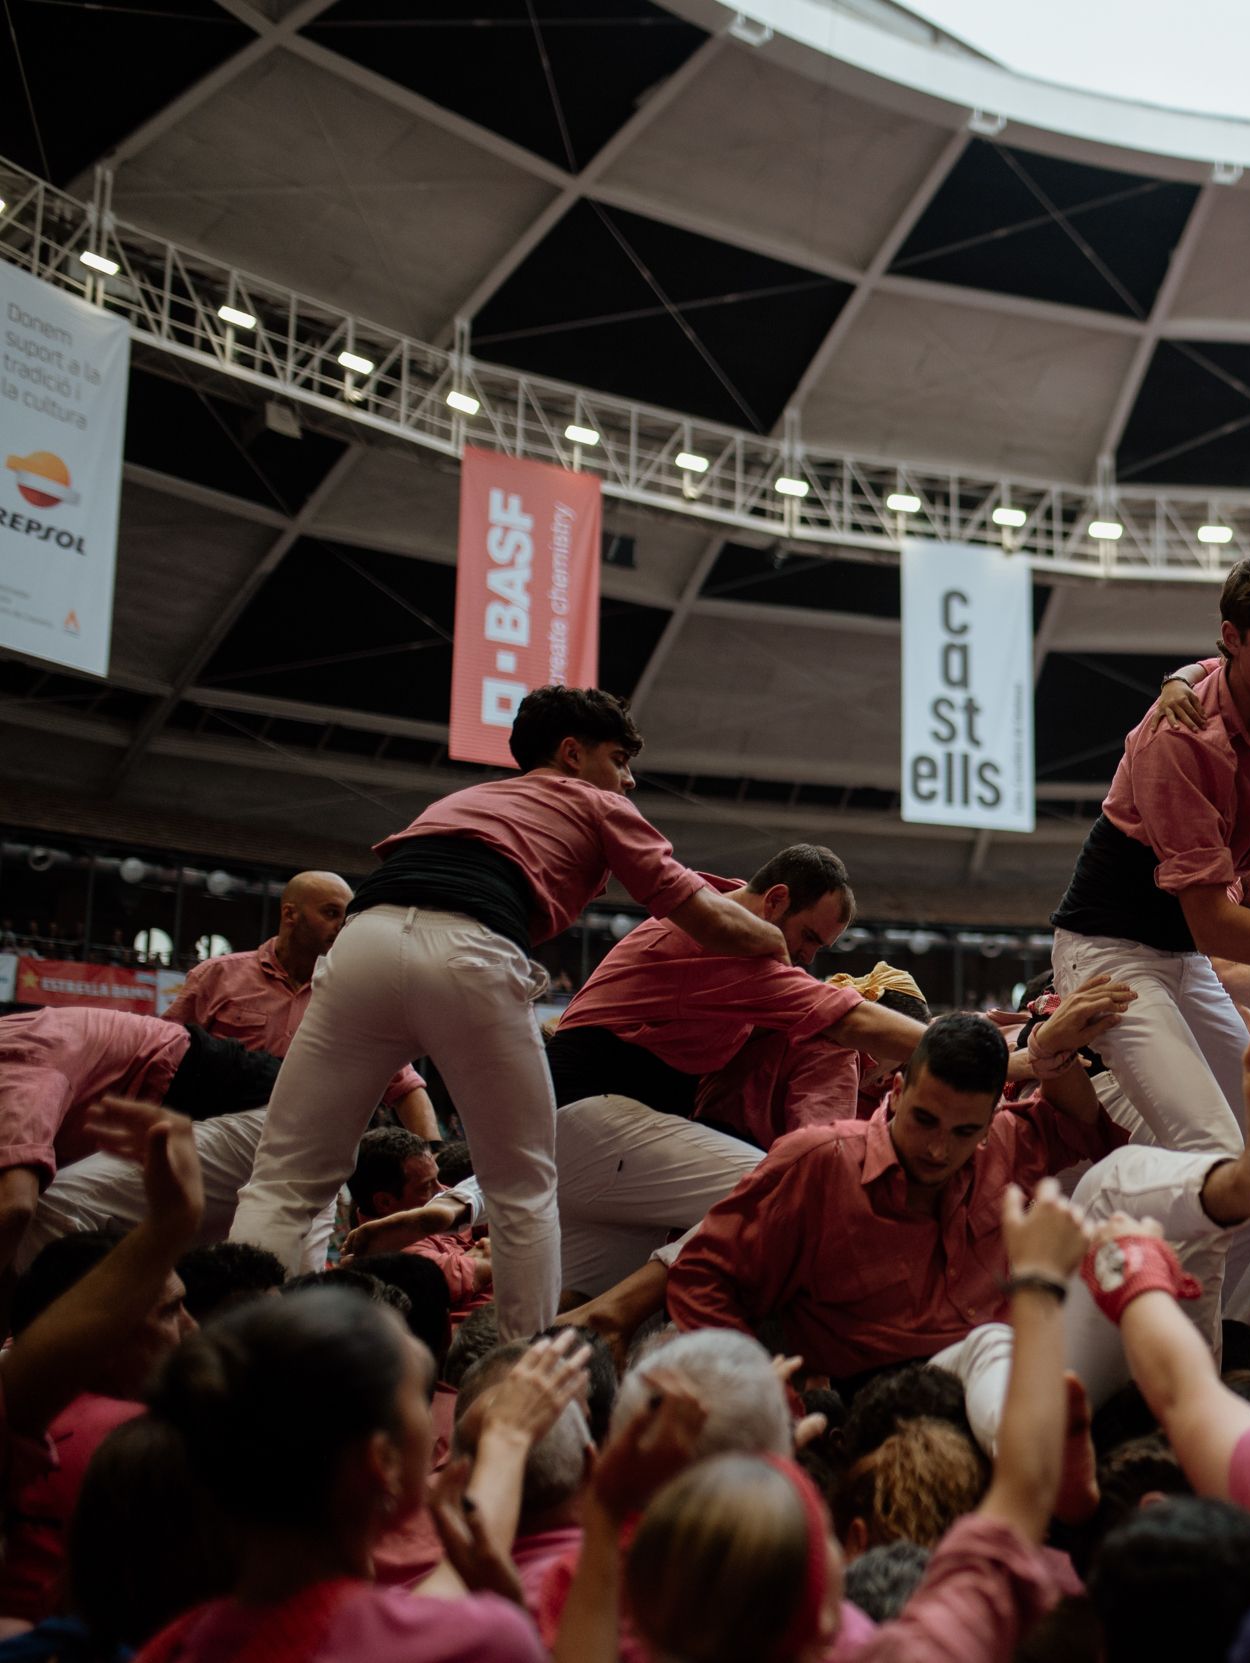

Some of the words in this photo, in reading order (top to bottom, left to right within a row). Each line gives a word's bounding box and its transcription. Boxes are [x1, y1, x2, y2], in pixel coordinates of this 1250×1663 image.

[7, 302, 73, 347] Donem
[3, 353, 72, 398] tradició
[5, 331, 64, 371] suport
[67, 359, 81, 377] a
[84, 361, 102, 386] la
[1, 377, 19, 400] la
[22, 391, 88, 430] cultura
[483, 488, 534, 648] BASF
[548, 502, 576, 616] chemistry
[930, 697, 982, 748] st
[911, 752, 1002, 808] ells
